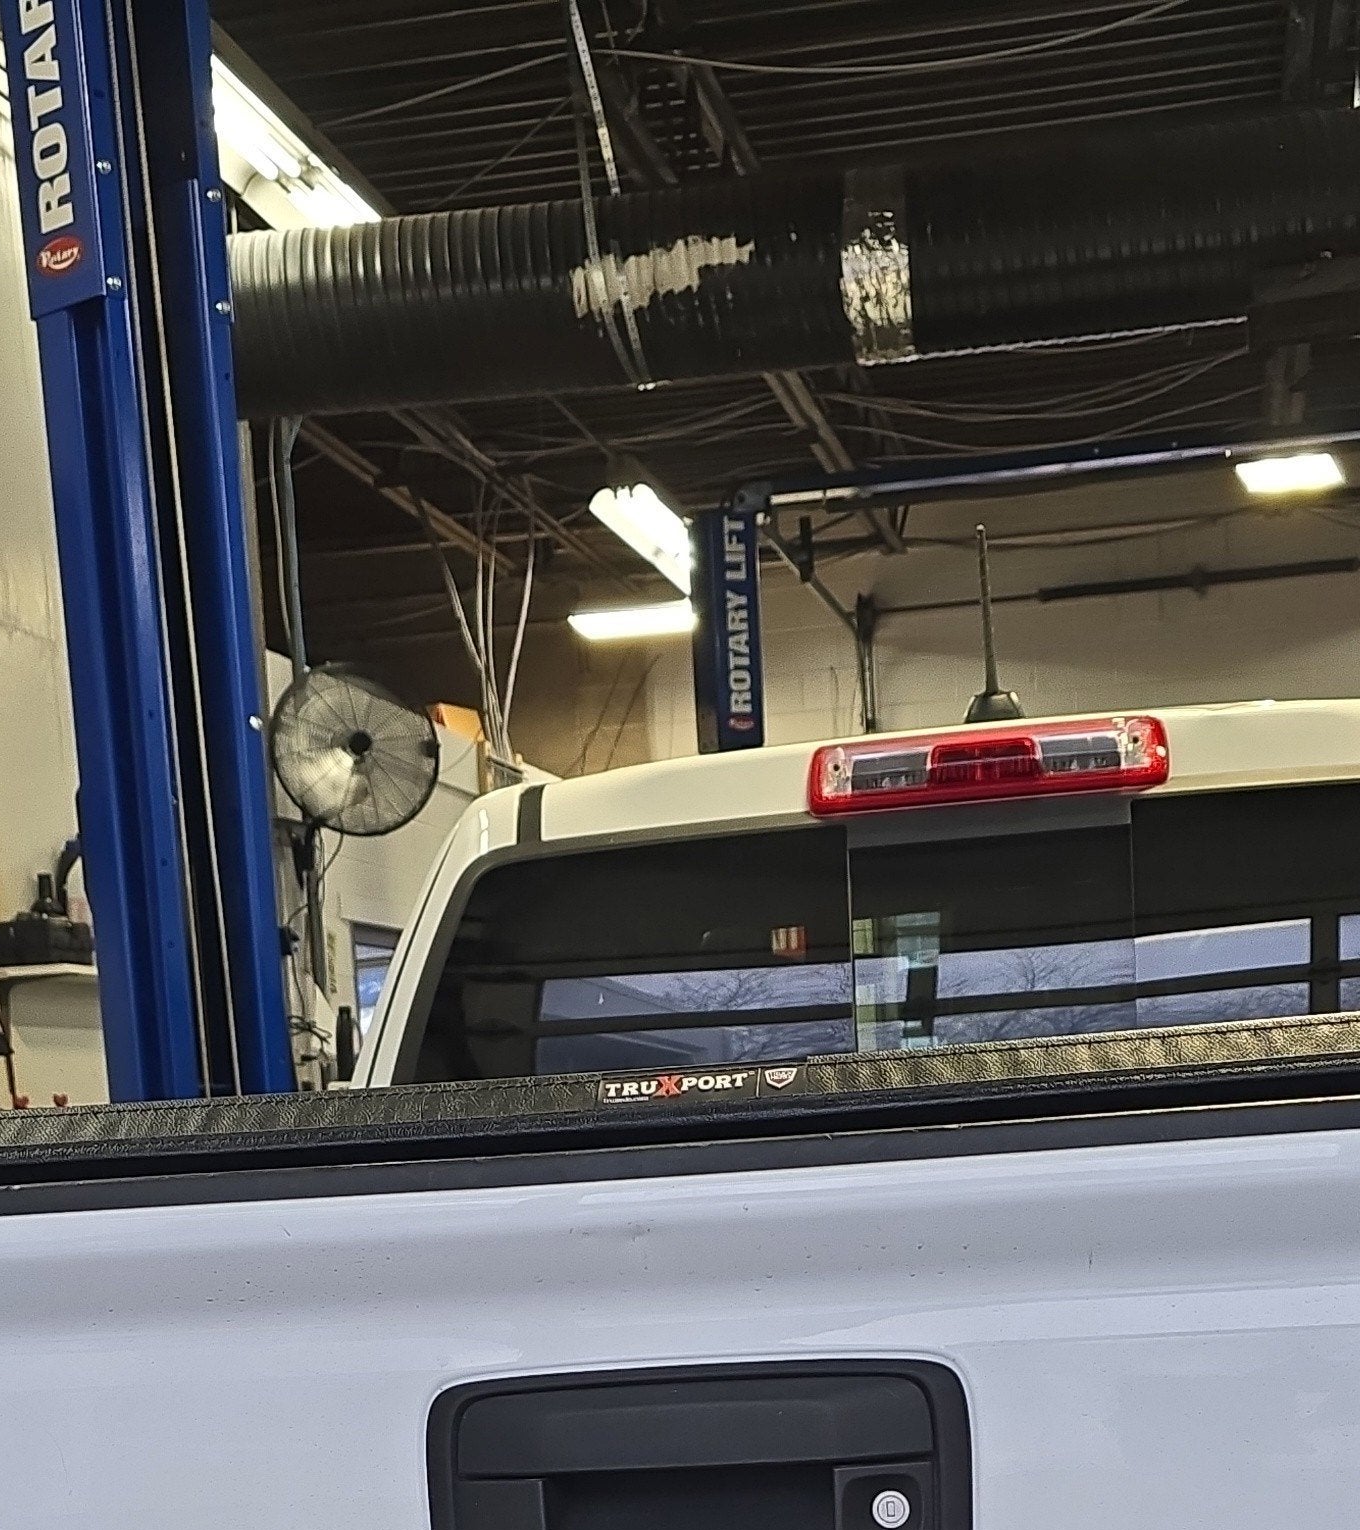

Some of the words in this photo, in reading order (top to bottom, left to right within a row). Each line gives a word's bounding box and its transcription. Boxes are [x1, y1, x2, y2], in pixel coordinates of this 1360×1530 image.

[724, 515, 747, 581] LIFT
[725, 590, 753, 714] ROTARY
[605, 1072, 749, 1098] TRUXPORT
